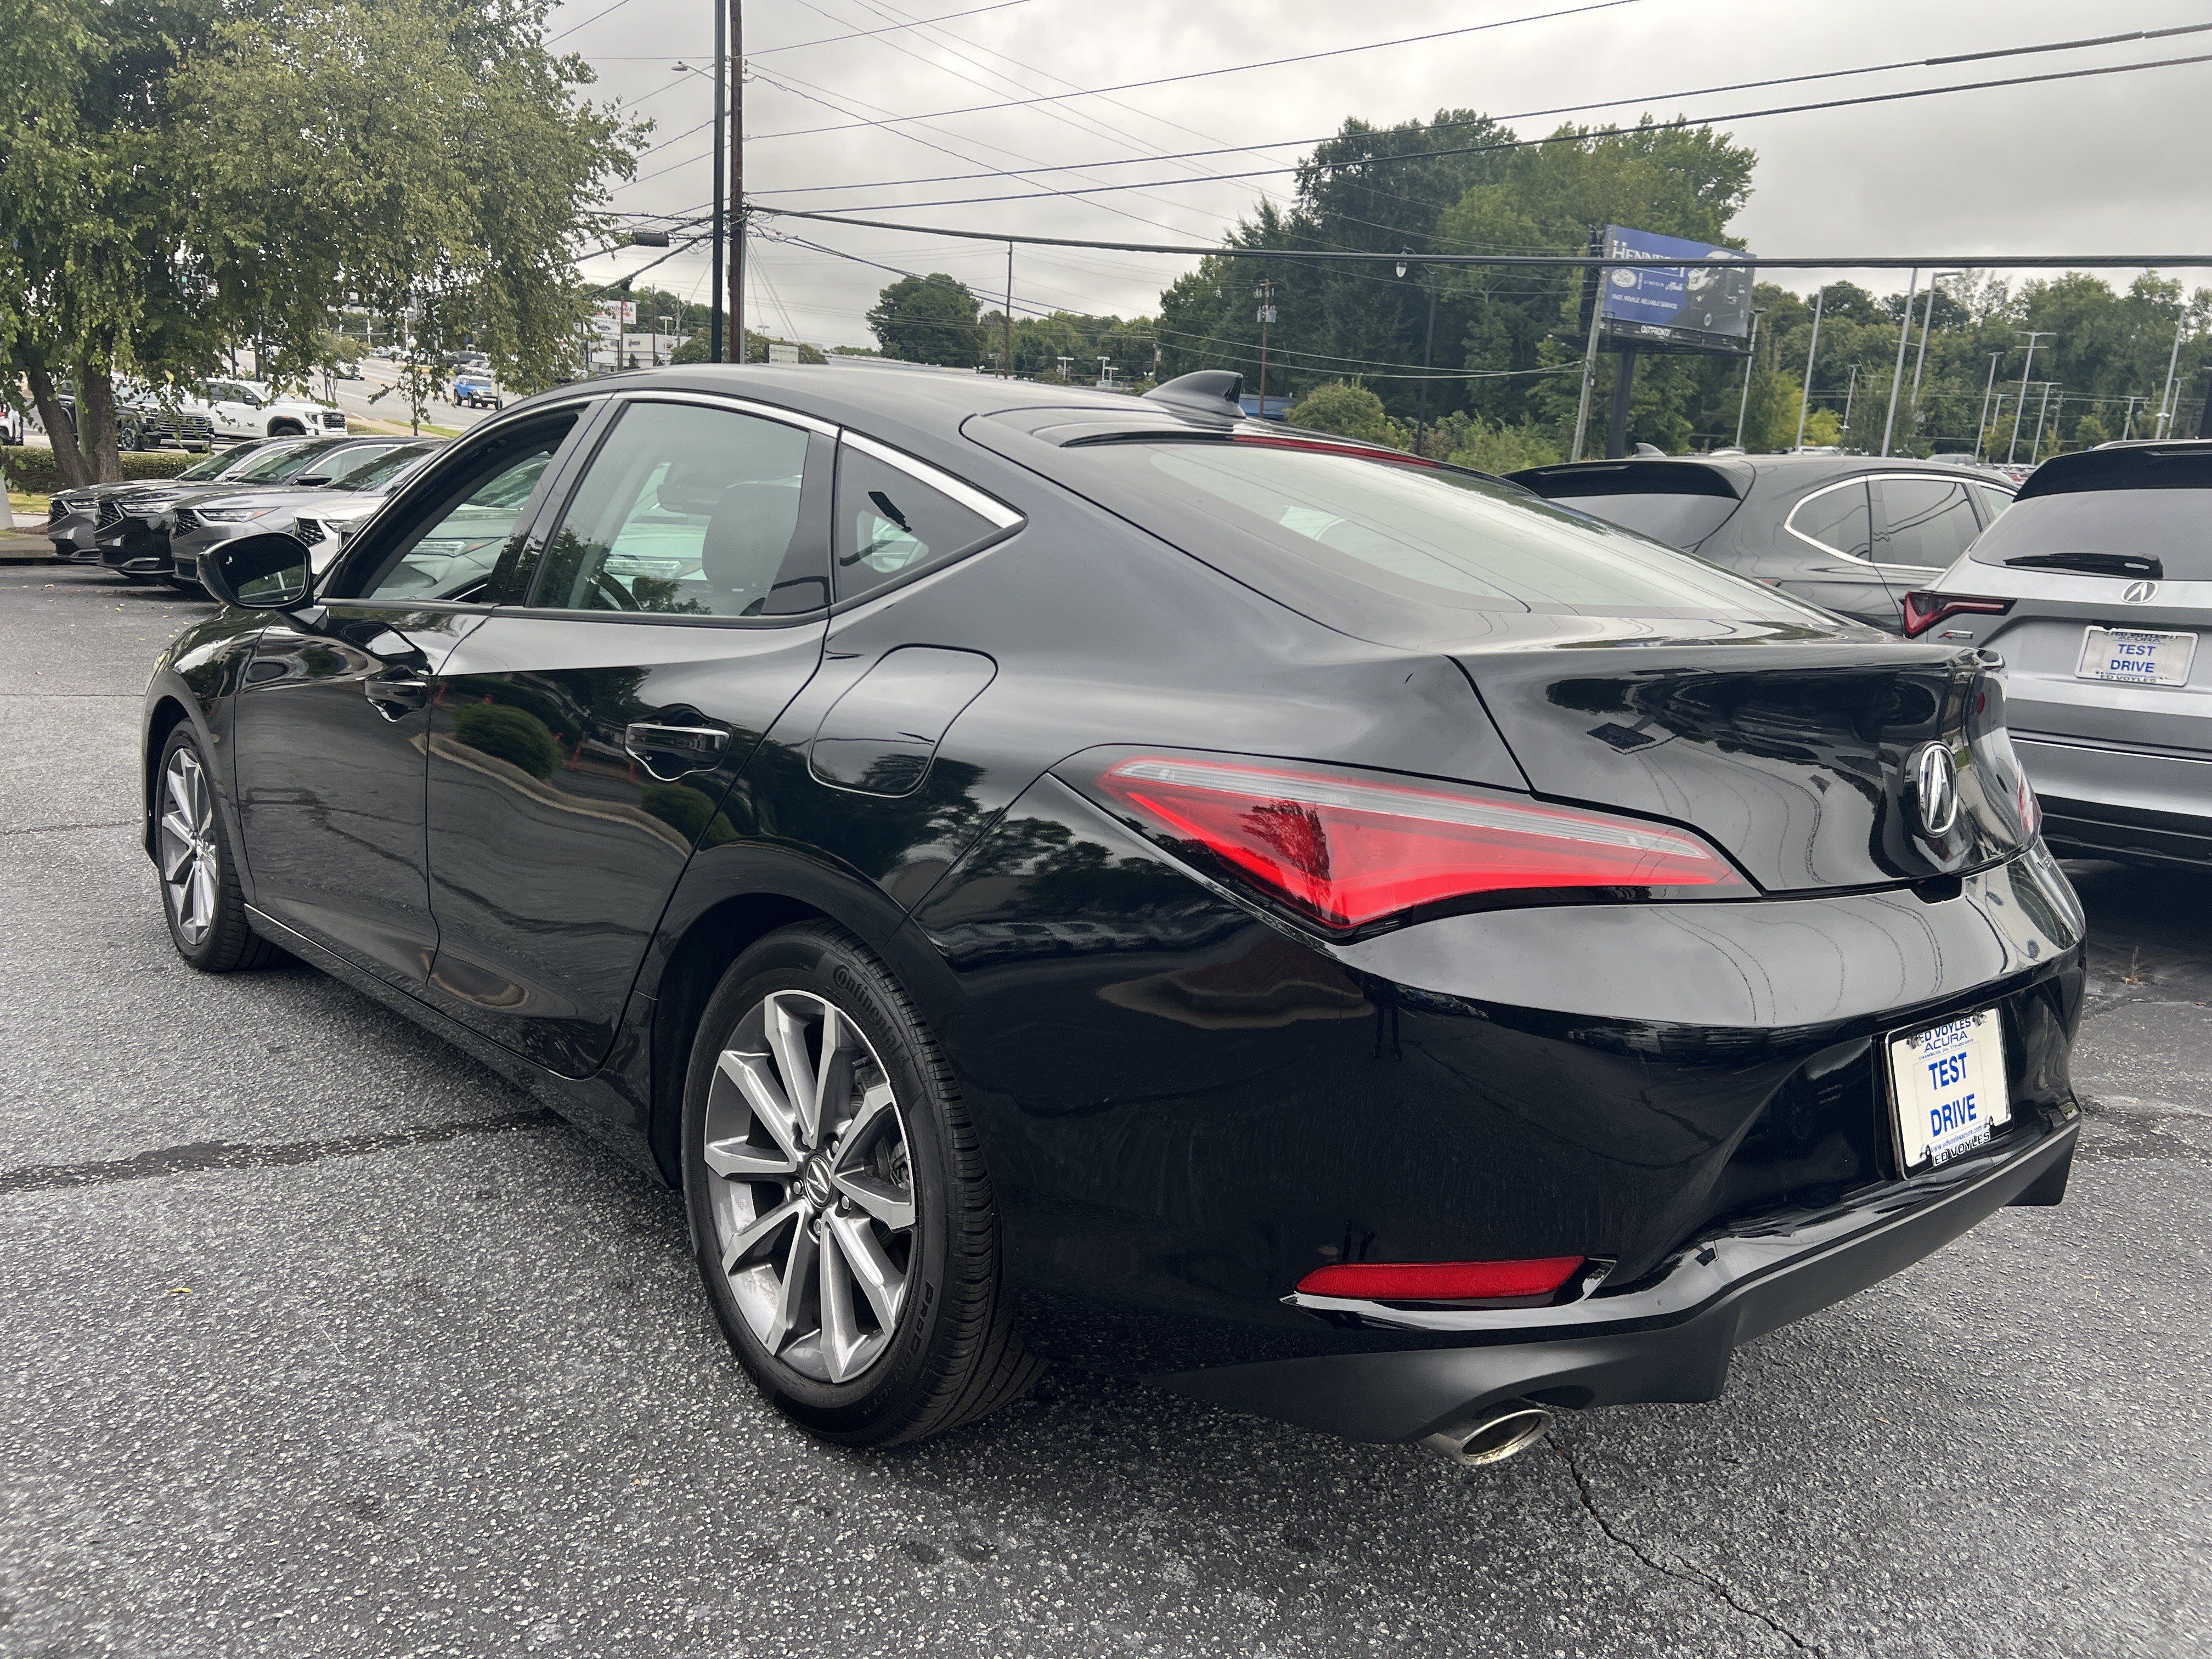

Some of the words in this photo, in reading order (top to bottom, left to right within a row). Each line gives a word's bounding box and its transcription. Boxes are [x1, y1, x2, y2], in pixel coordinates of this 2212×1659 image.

[2118, 644, 2156, 656] TEST
[2110, 659, 2155, 673] DRIVE
[833, 964, 905, 1055] Continental
[1924, 1030, 1968, 1053] ACURA
[1934, 1018, 1971, 1038] VOYLES
[1928, 1051, 1967, 1090] TEST
[1930, 1093, 1977, 1137] DRIVE
[1934, 1152, 1948, 1165] ED
[1950, 1132, 1990, 1157] VOYLES
